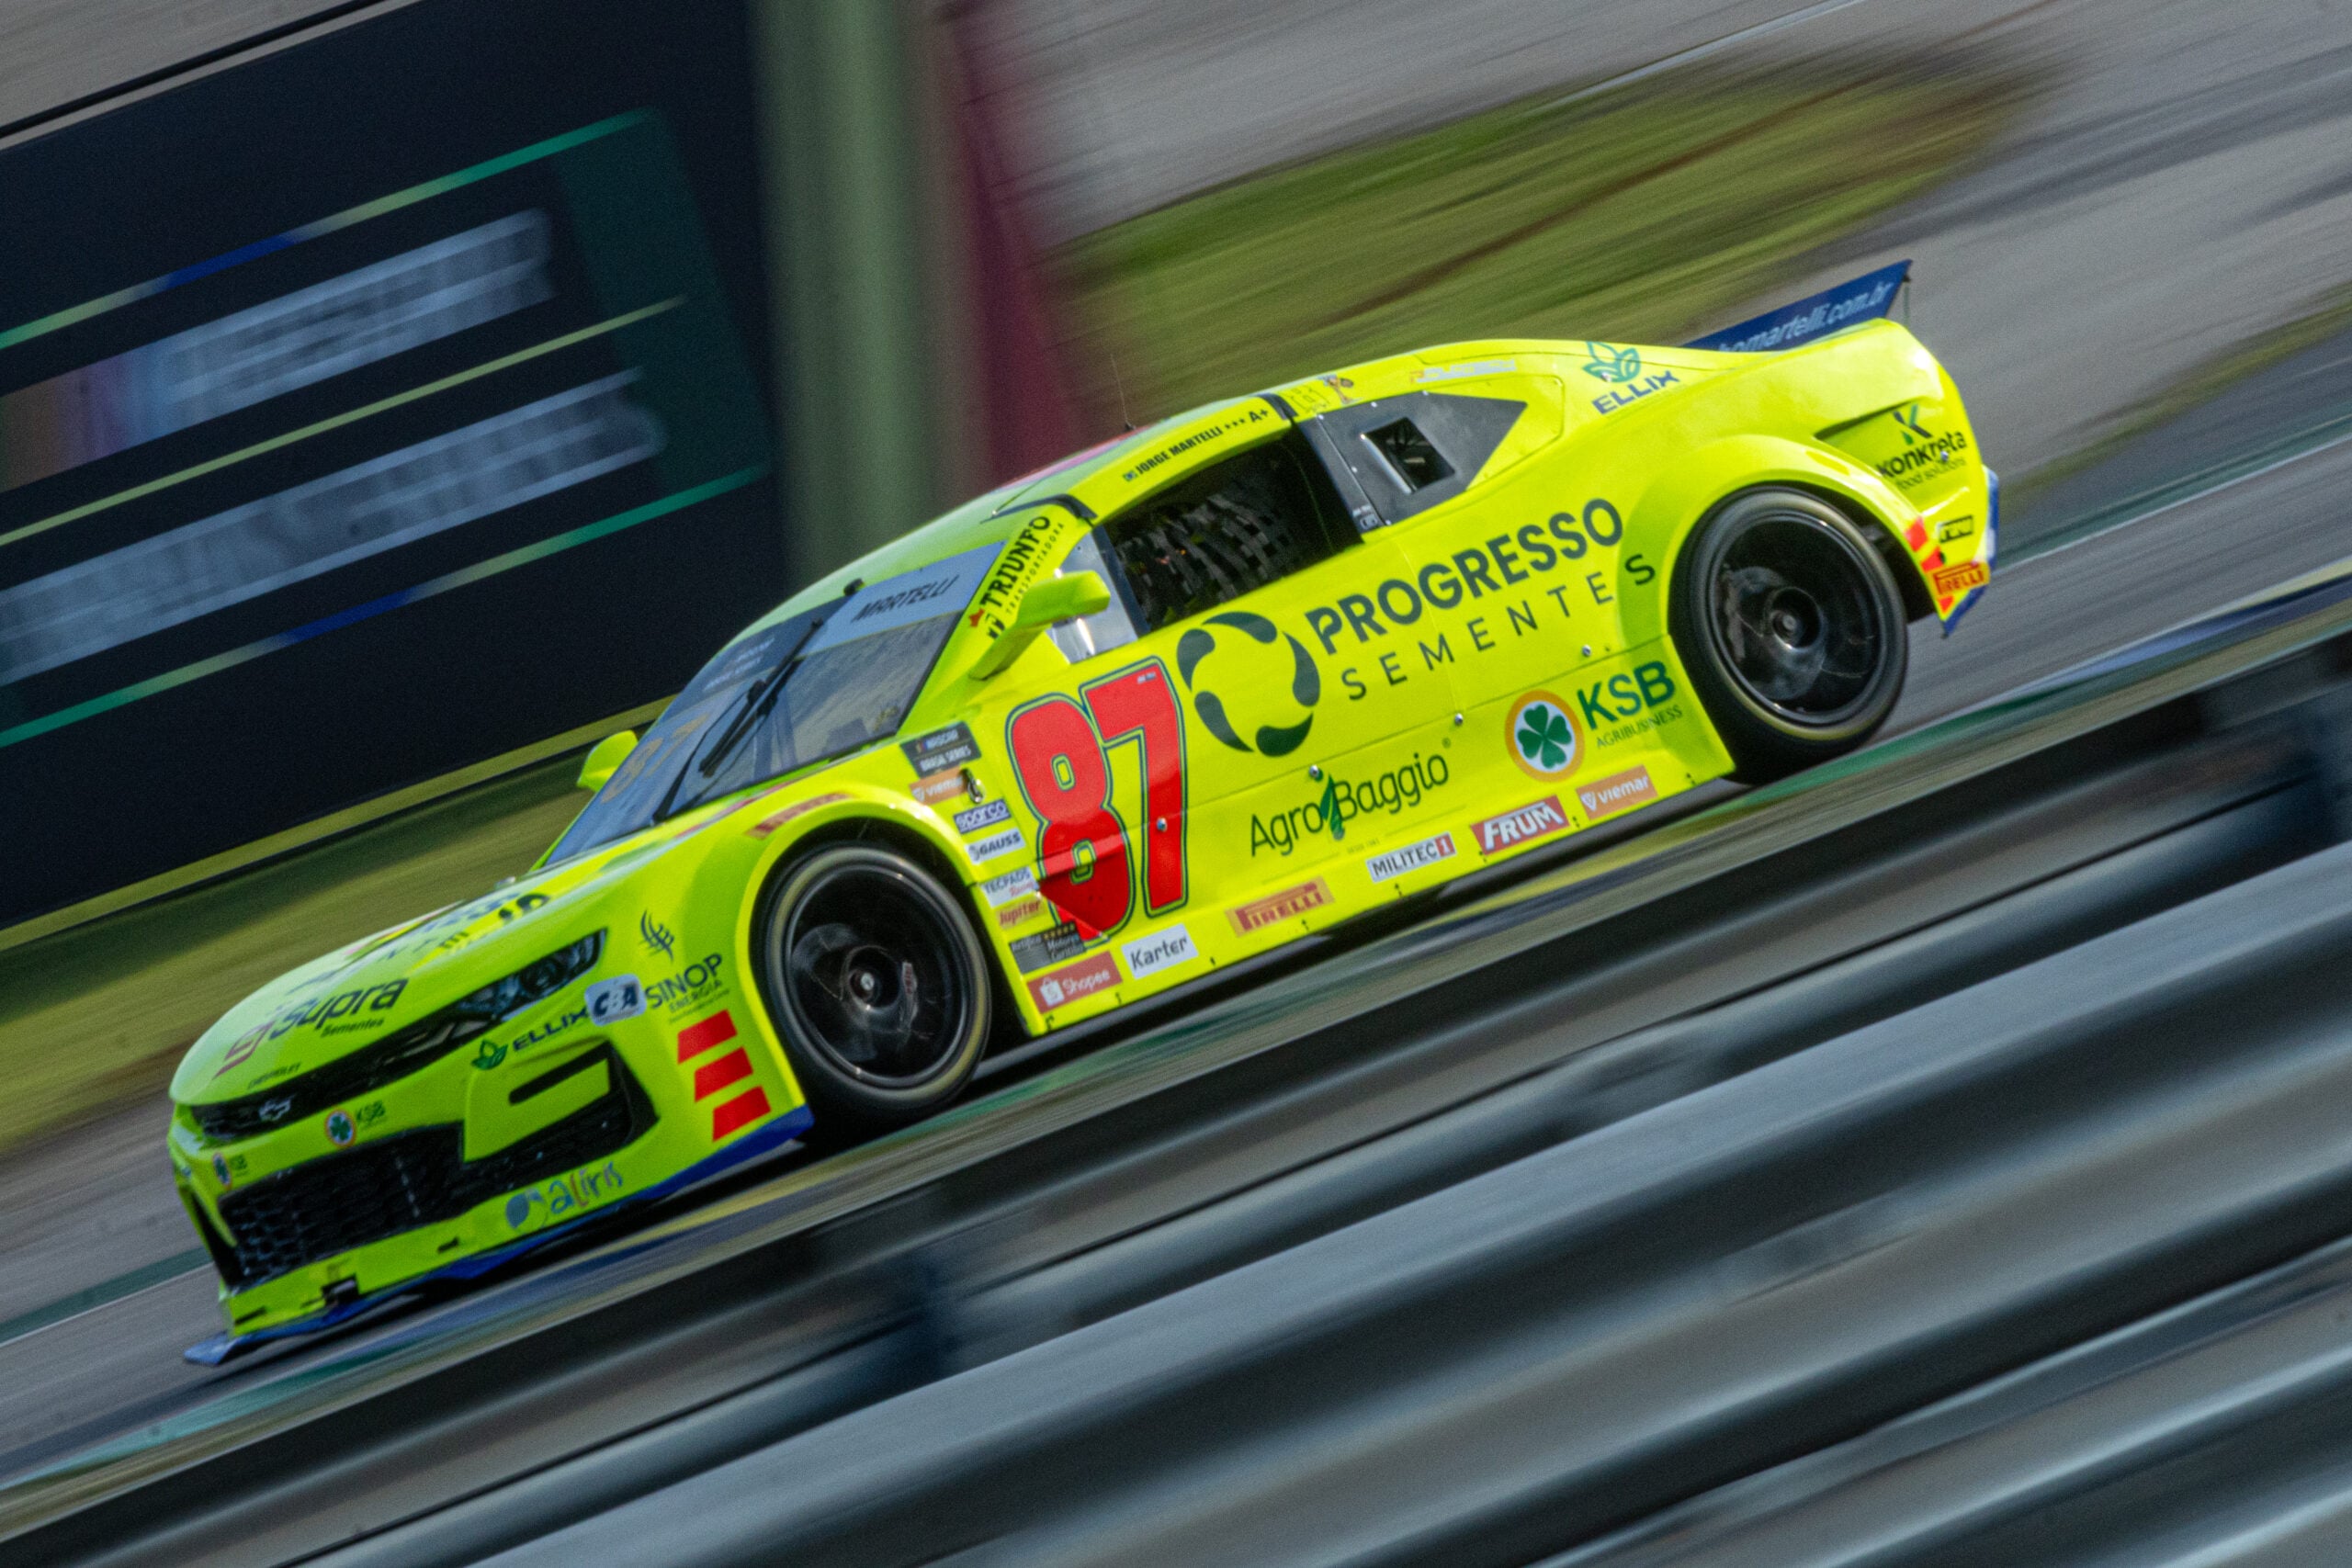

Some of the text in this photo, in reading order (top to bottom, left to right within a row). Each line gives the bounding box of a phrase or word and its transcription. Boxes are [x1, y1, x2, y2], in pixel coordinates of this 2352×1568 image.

[1592, 369, 1679, 414] ELLIX
[1136, 451, 1170, 474] JORGE
[1168, 426, 1224, 457] MARTELLI
[1875, 431, 1967, 478] konkreta
[979, 515, 1050, 609] TRIUNFO
[1006, 523, 1065, 615] TRANSPORTADORA
[1303, 498, 1623, 656] PROGRESSO
[1340, 553, 1656, 701] SEMENTES
[1577, 660, 1676, 730] KSB
[1595, 704, 1683, 750] AGRIBUSINESS
[1006, 656, 1188, 948] 87
[1597, 775, 1650, 804] viemar
[979, 831, 1022, 853] GAUSS
[1484, 802, 1564, 850] FRUM
[1235, 882, 1323, 932] PIRELLI
[1130, 933, 1188, 972] Karter
[644, 953, 723, 1009] SINOP
[1062, 968, 1111, 996] Shopee
